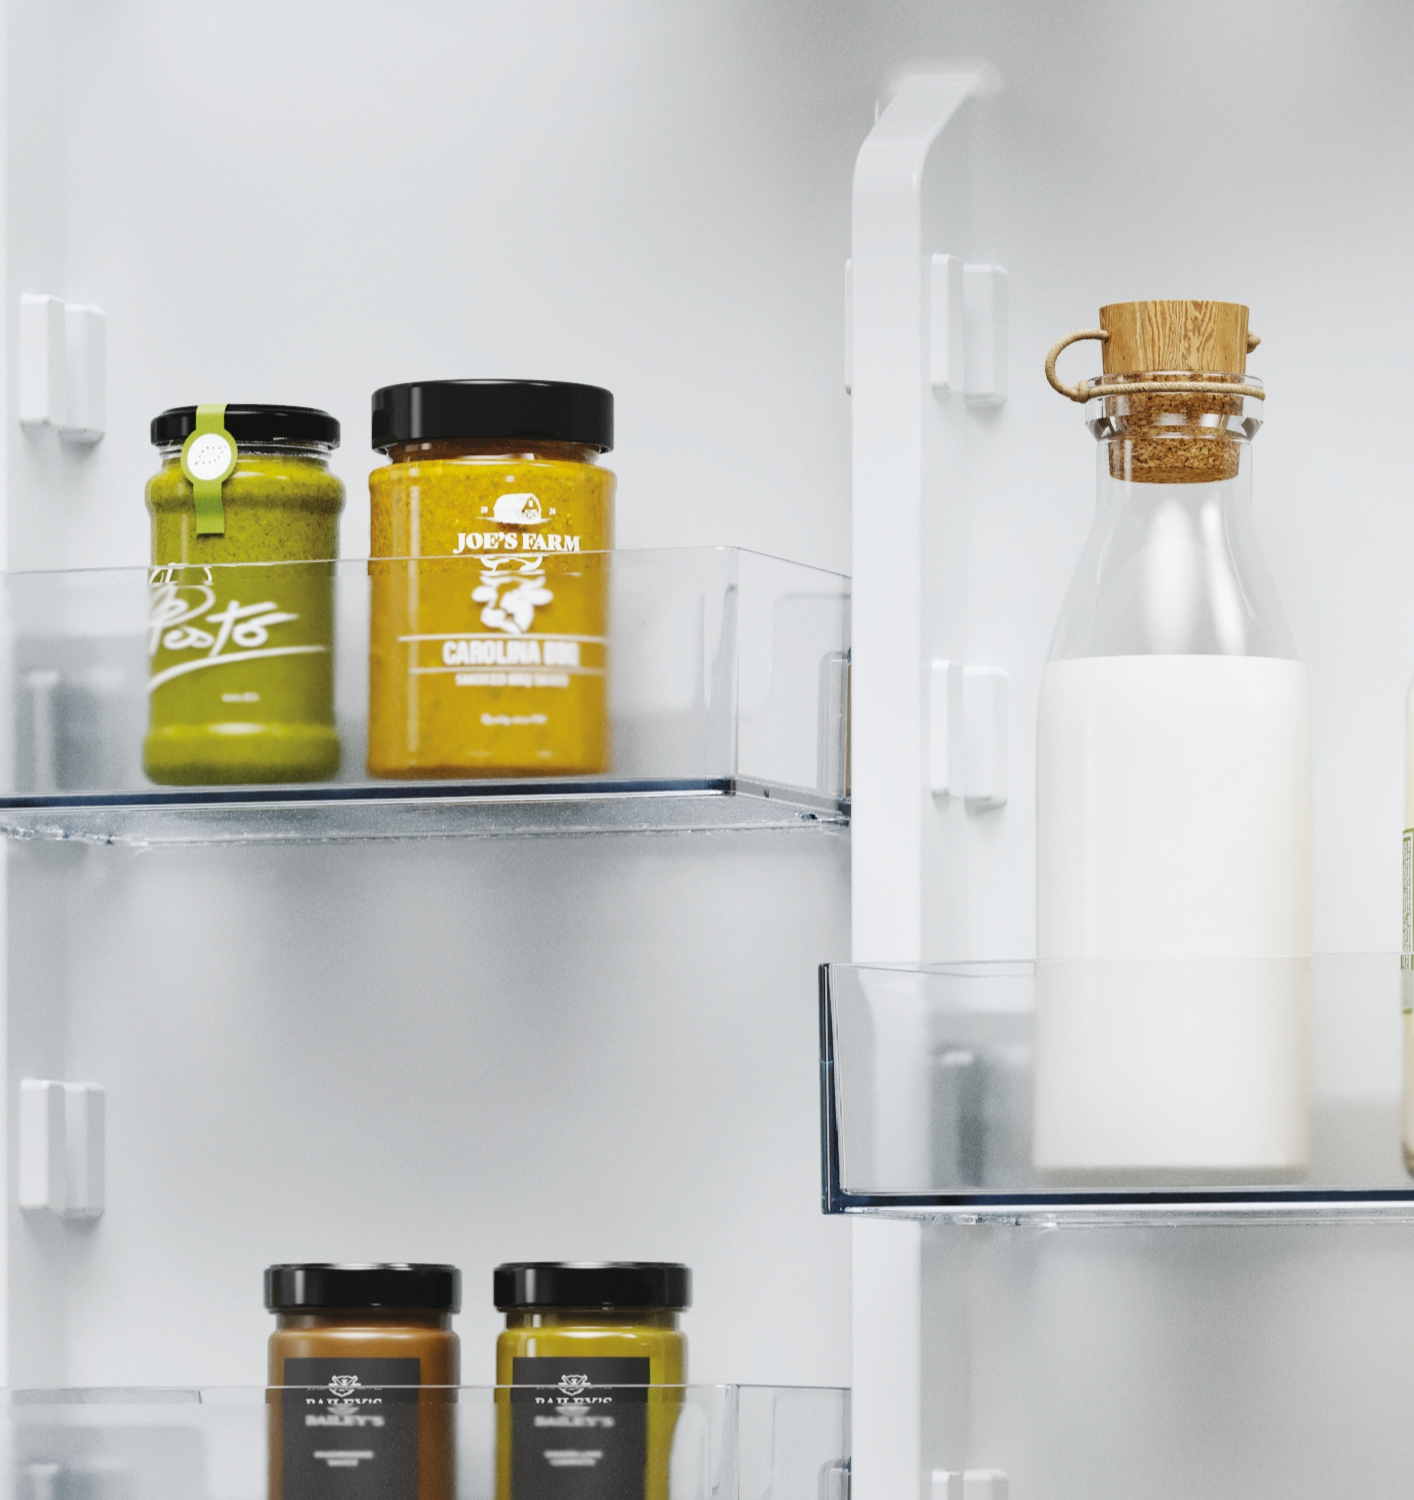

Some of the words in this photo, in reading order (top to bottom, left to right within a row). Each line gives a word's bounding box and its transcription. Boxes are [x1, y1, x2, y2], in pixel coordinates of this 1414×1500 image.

[452, 531, 518, 555] JOE'S
[521, 533, 580, 553] FARM
[442, 639, 542, 667] CAROLINA
